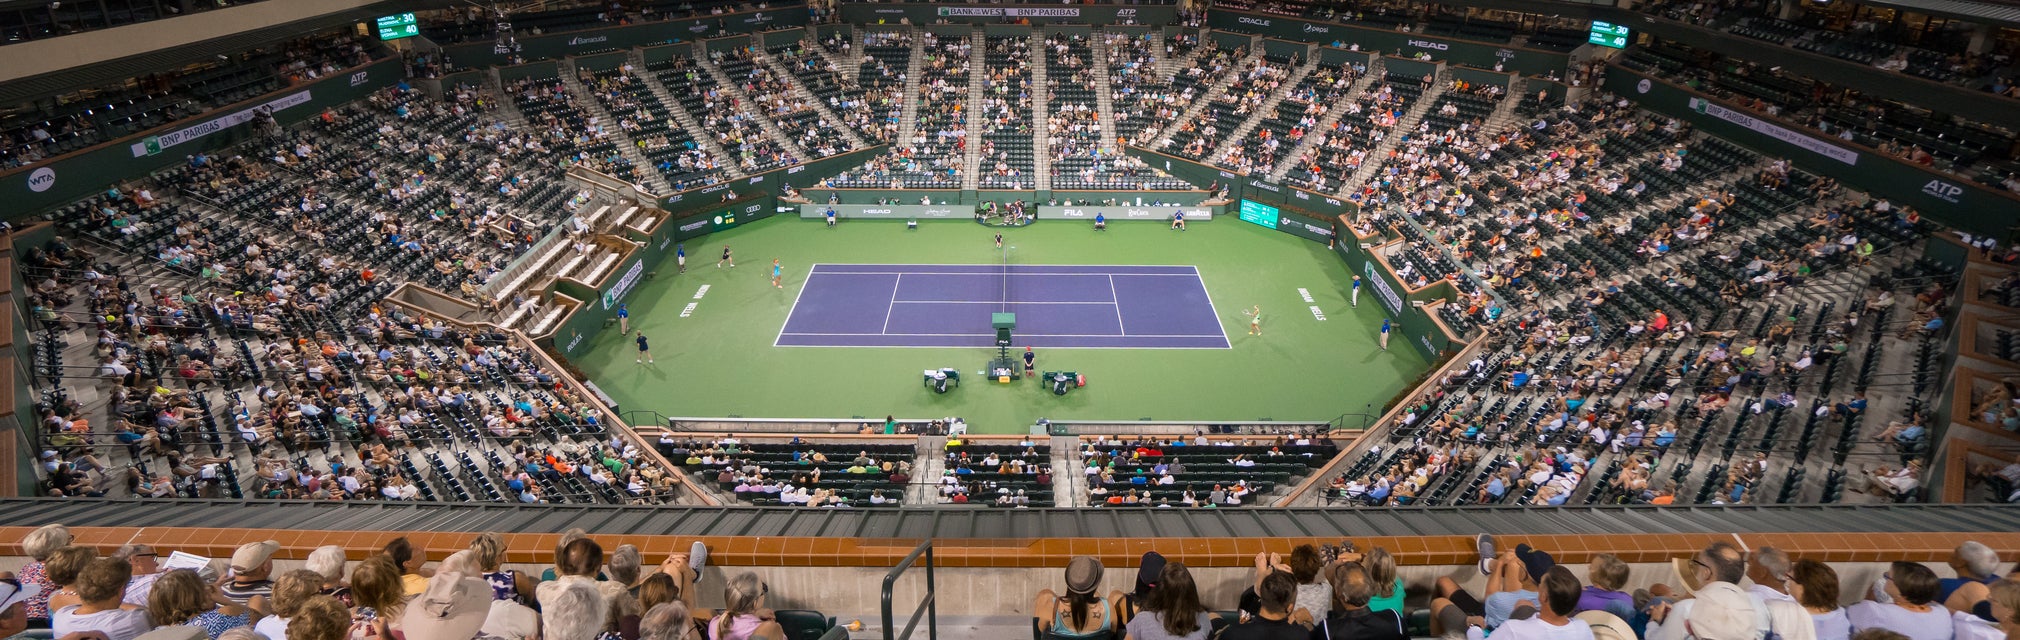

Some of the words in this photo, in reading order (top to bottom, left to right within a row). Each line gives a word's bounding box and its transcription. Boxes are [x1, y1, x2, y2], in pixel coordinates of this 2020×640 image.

[403, 13, 414, 22] 30
[1238, 16, 1271, 26] ORACLE
[406, 24, 417, 33] 40
[1616, 25, 1628, 34] 30
[578, 36, 607, 45] Barracuda
[1408, 39, 1448, 51] HEAD
[1613, 37, 1625, 46] 40
[494, 44, 522, 54] Herz
[351, 71, 367, 83] ATP
[1708, 104, 1722, 115] BNP
[1723, 110, 1752, 127] PARIBAS
[160, 134, 180, 147] BNP
[184, 121, 220, 139] PARIBAS
[30, 174, 55, 185] WTA
[702, 183, 730, 193] ORACLE
[1258, 182, 1279, 192] Barracuda
[1924, 180, 1963, 196] ATP
[1326, 198, 1340, 206] WTA
[613, 282, 622, 297] BNP
[623, 262, 642, 287] PARIBAS
[567, 333, 583, 352] ROLEX
